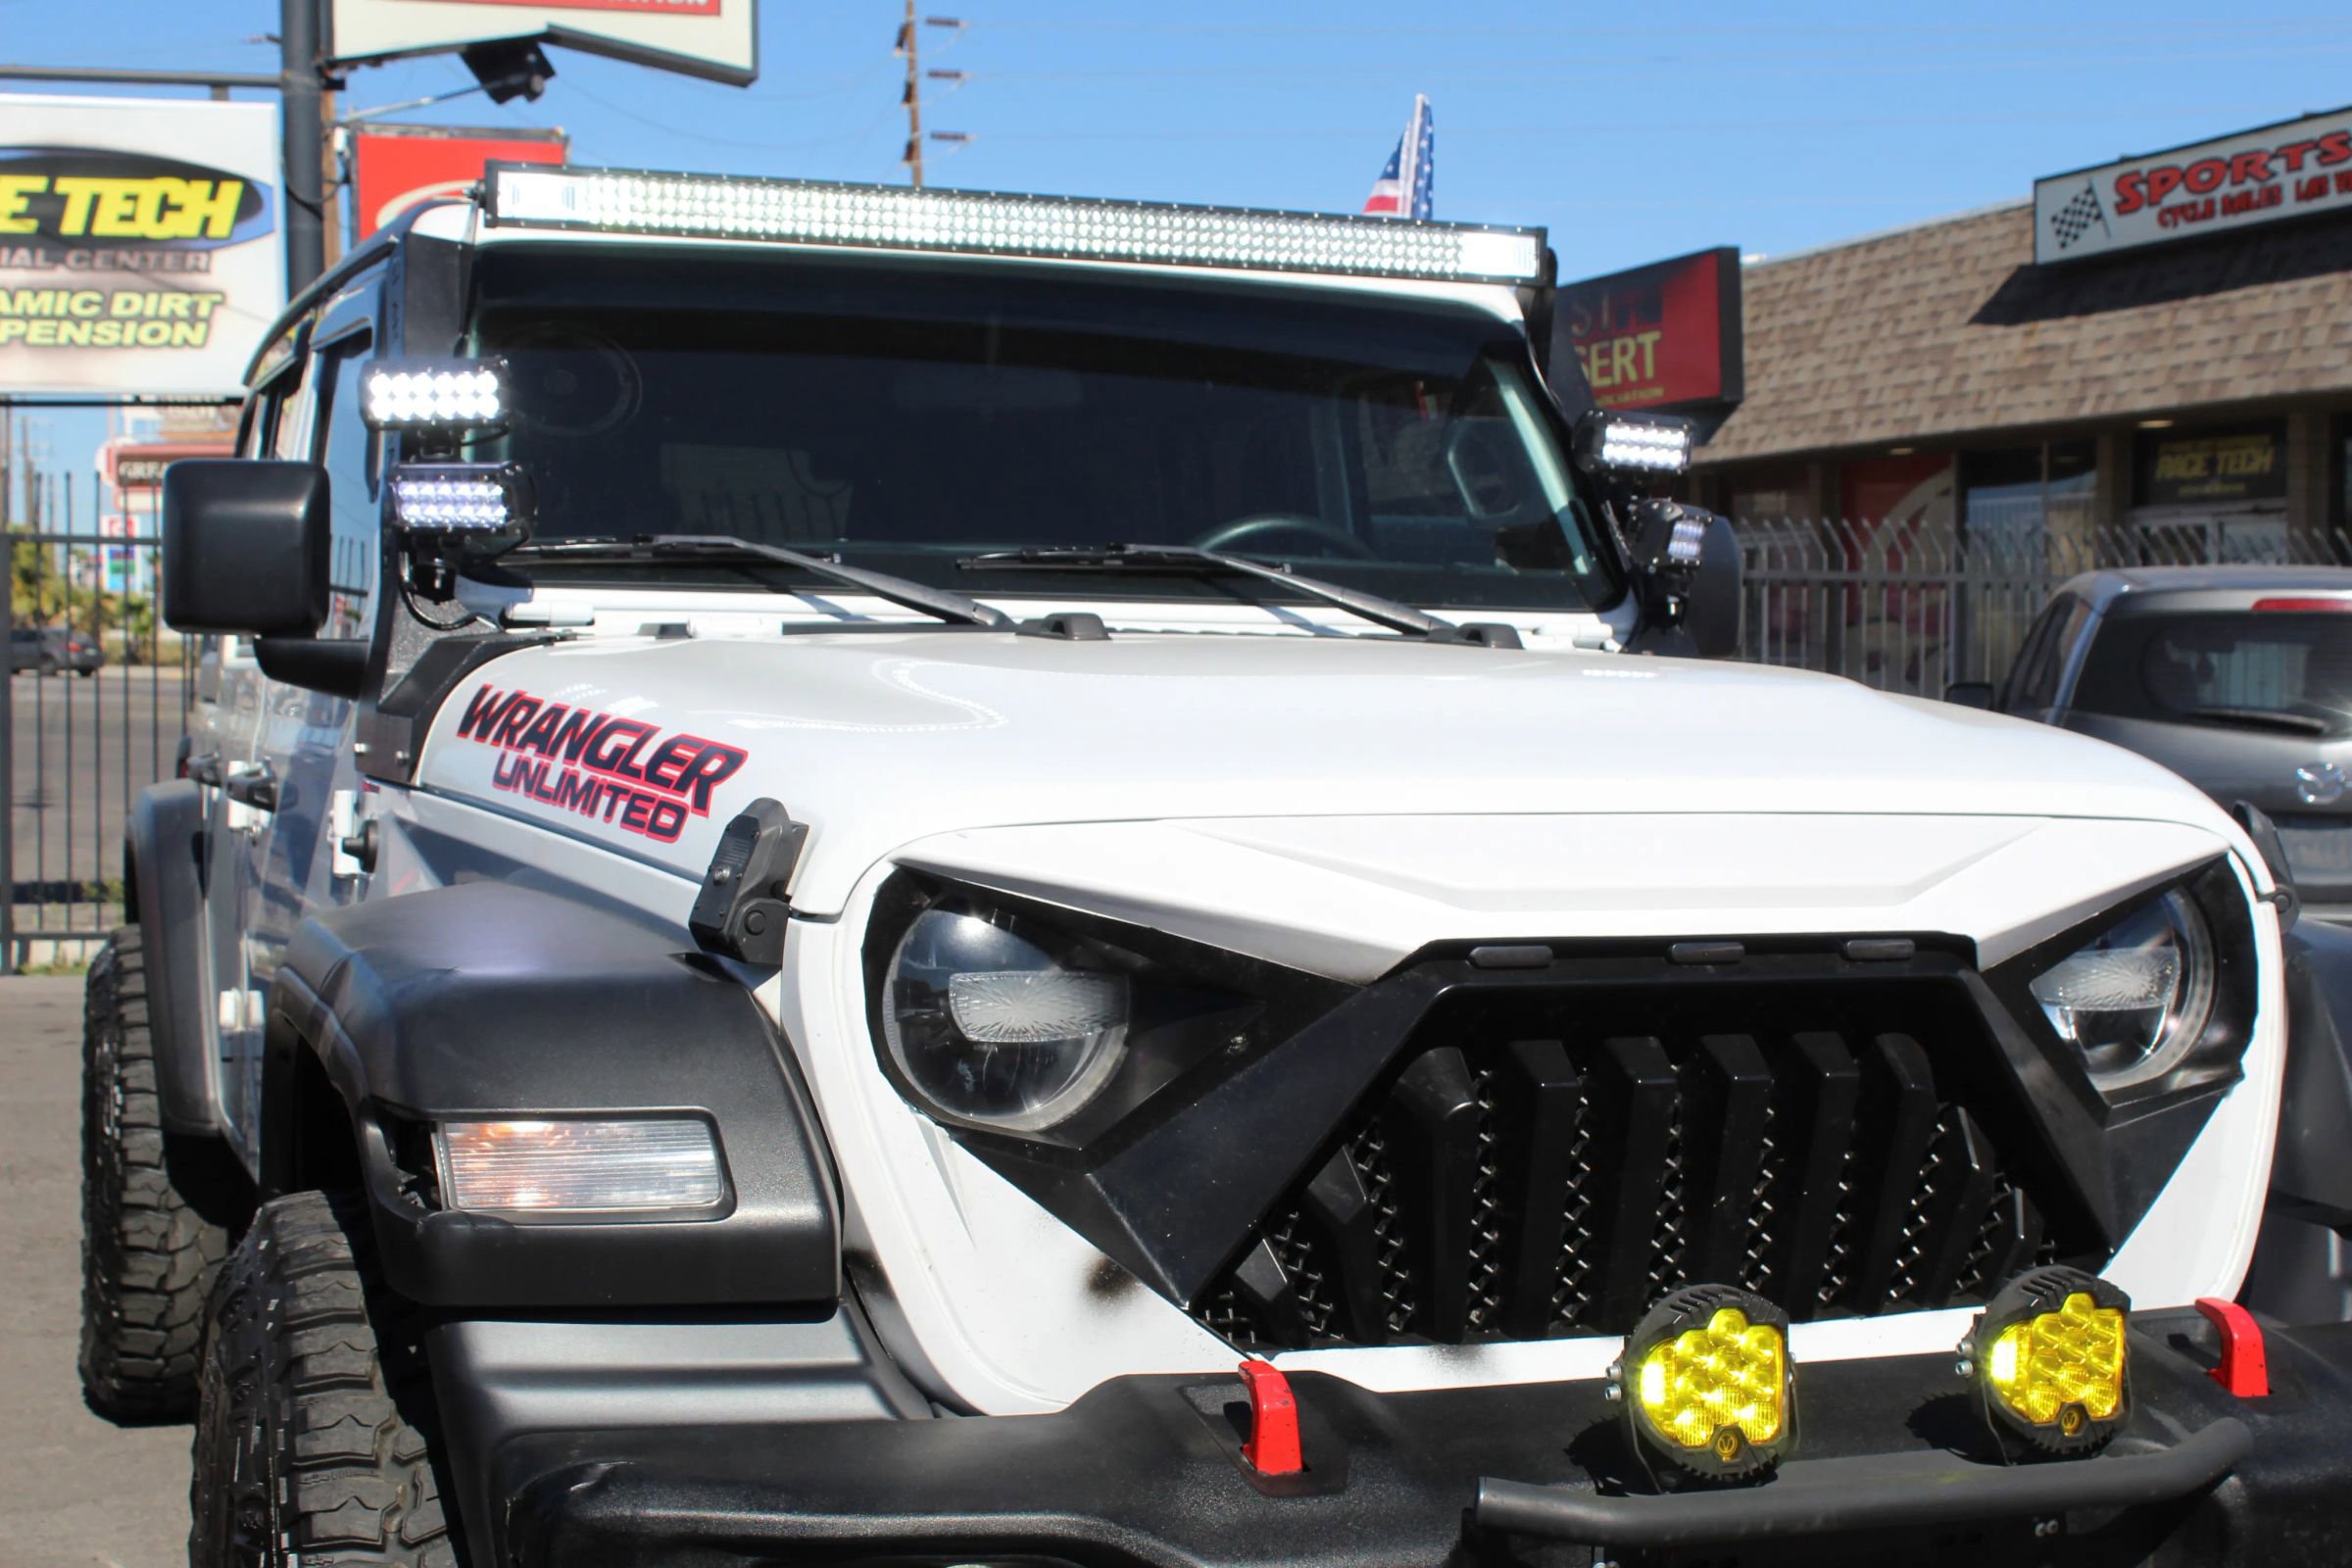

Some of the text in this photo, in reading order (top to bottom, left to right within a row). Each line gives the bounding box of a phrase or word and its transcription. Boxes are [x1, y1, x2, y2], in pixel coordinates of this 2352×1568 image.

[2114, 129, 2352, 216] SPORTS
[54, 176, 244, 239] TECH
[2158, 199, 2216, 228] CYCLE
[65, 247, 212, 272] CENTER
[109, 291, 225, 318] DIRT
[0, 318, 209, 347] PENSION
[456, 683, 750, 818] WRANGLER
[491, 750, 691, 845] UNLIMITED
